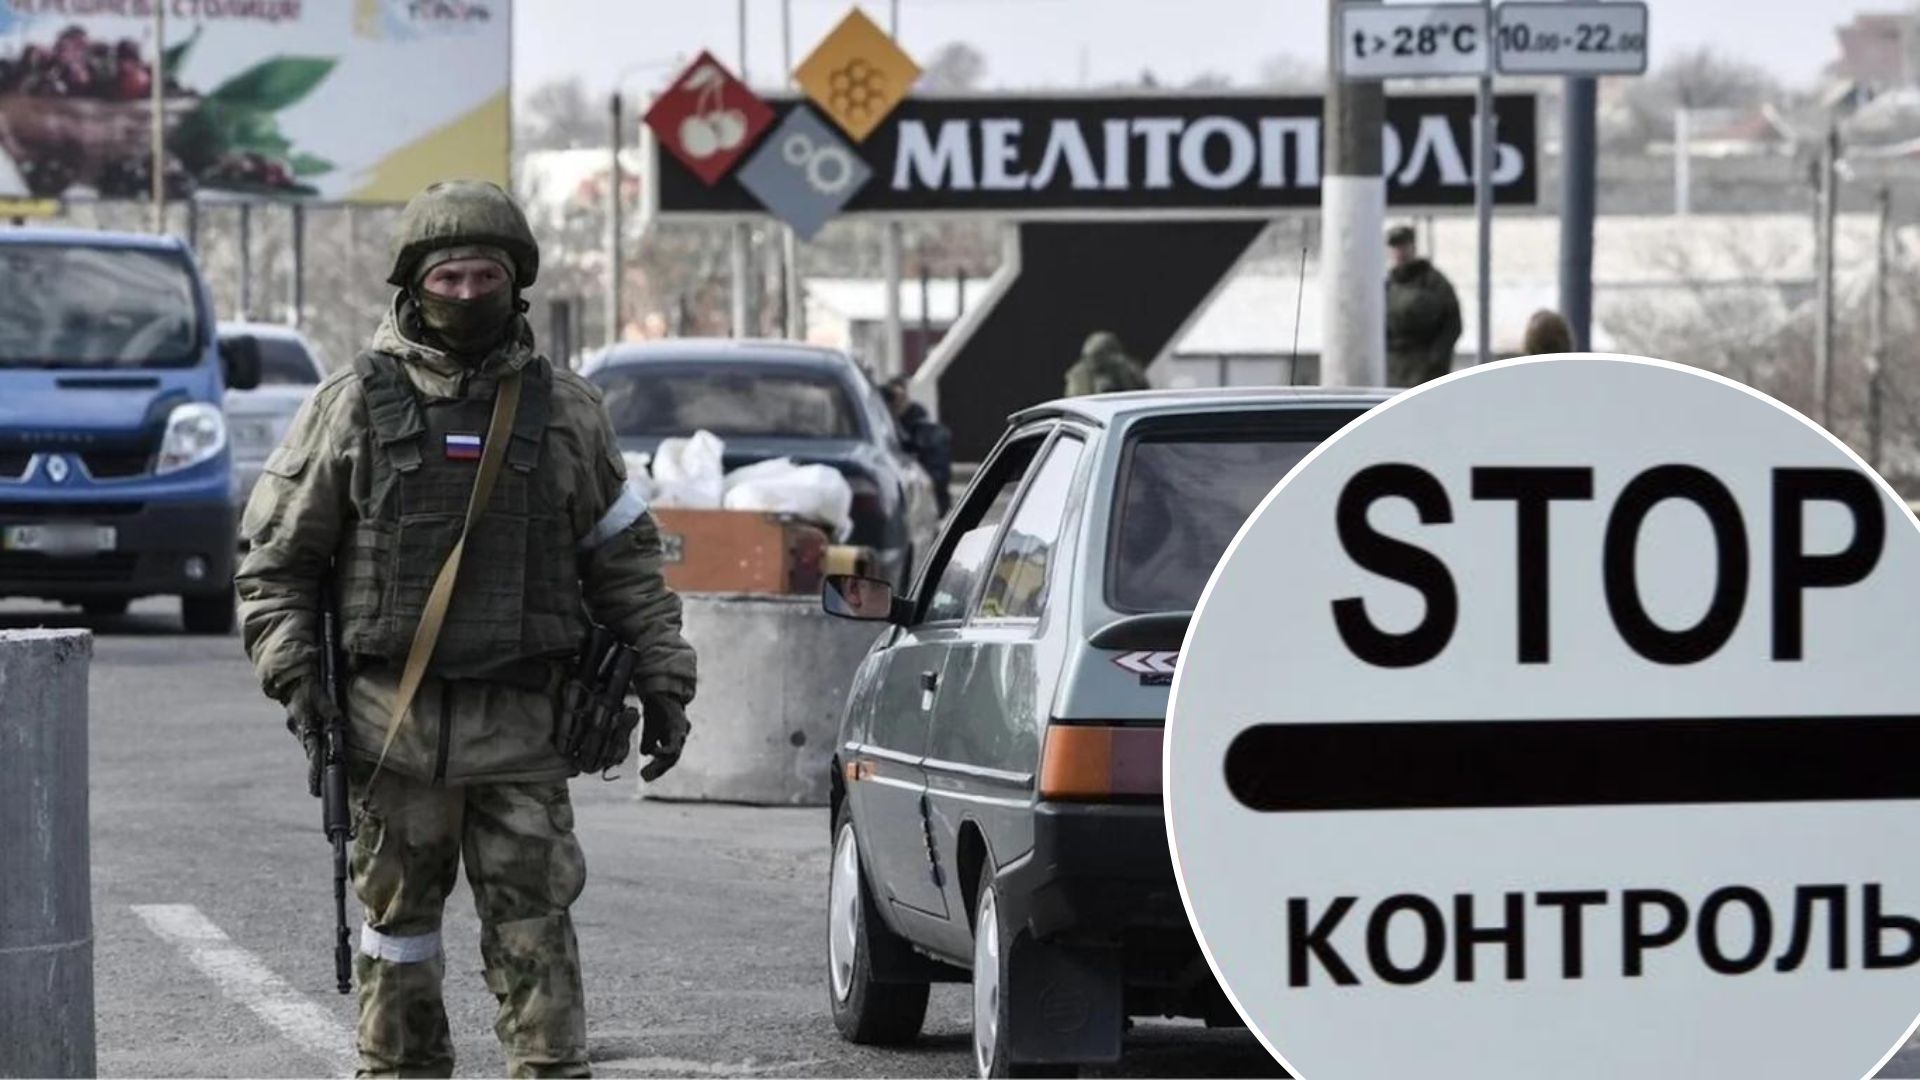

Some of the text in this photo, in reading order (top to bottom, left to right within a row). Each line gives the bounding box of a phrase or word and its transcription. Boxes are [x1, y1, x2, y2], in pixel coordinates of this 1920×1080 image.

[892, 117, 1525, 190] МЕЛІТОПЛЬ
[1331, 462, 1886, 668] STOP
[1287, 883, 1920, 987] КОНТРОЛЬ
